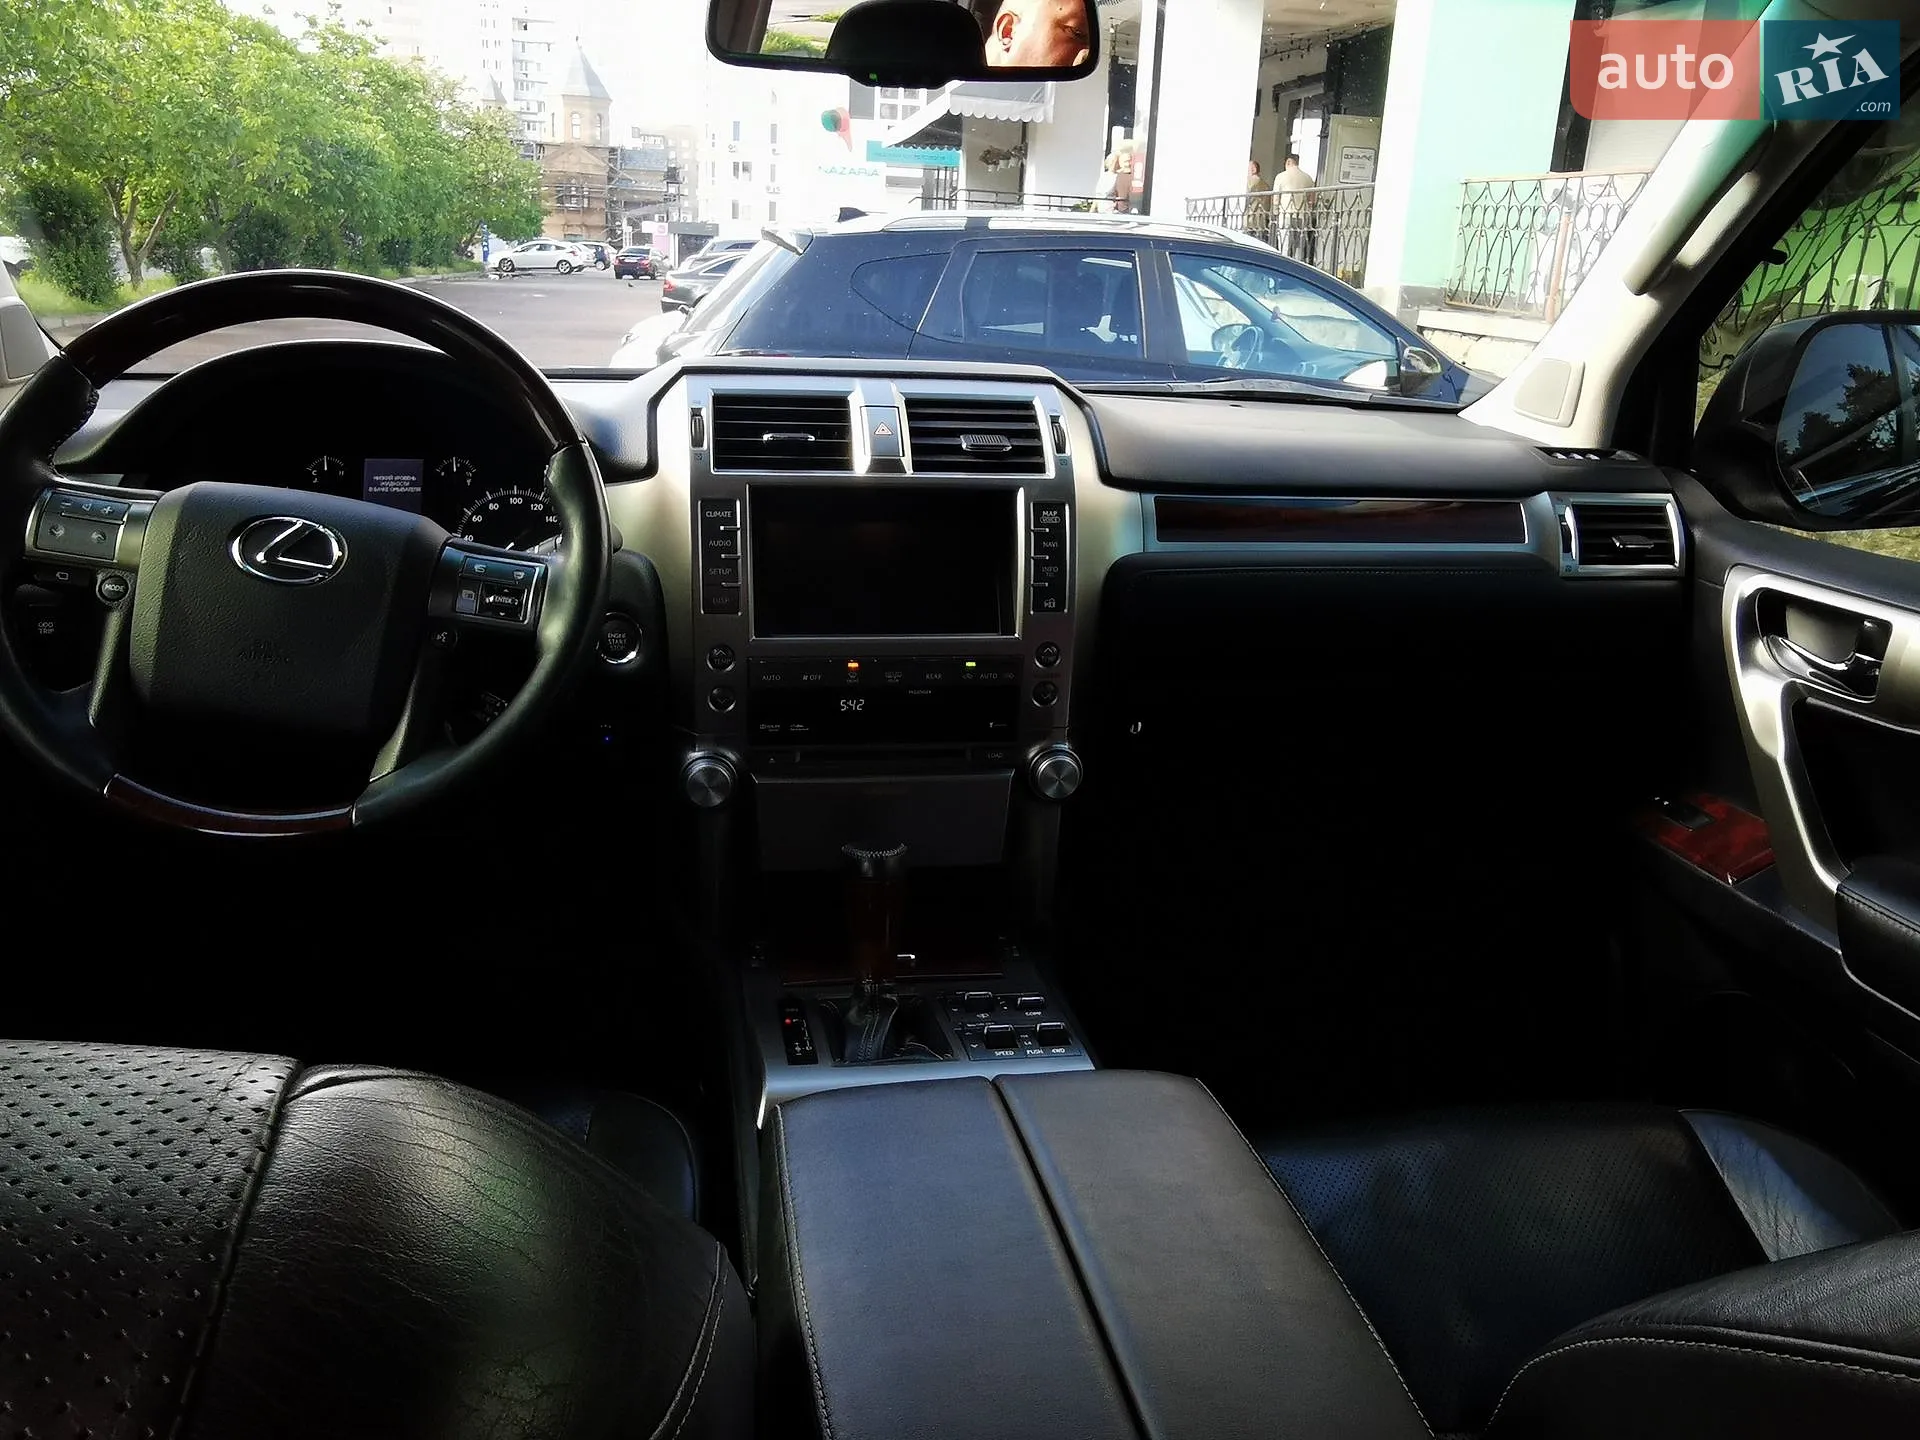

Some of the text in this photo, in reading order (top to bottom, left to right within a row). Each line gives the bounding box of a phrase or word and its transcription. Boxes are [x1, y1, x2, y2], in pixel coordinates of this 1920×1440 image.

[509, 497, 523, 505] 100
[488, 502, 500, 511] 80
[530, 503, 544, 511] 120
[705, 510, 733, 518] CLIMATE
[472, 514, 483, 523] 60
[104, 584, 126, 592] MODE
[840, 699, 865, 712] 5:42
